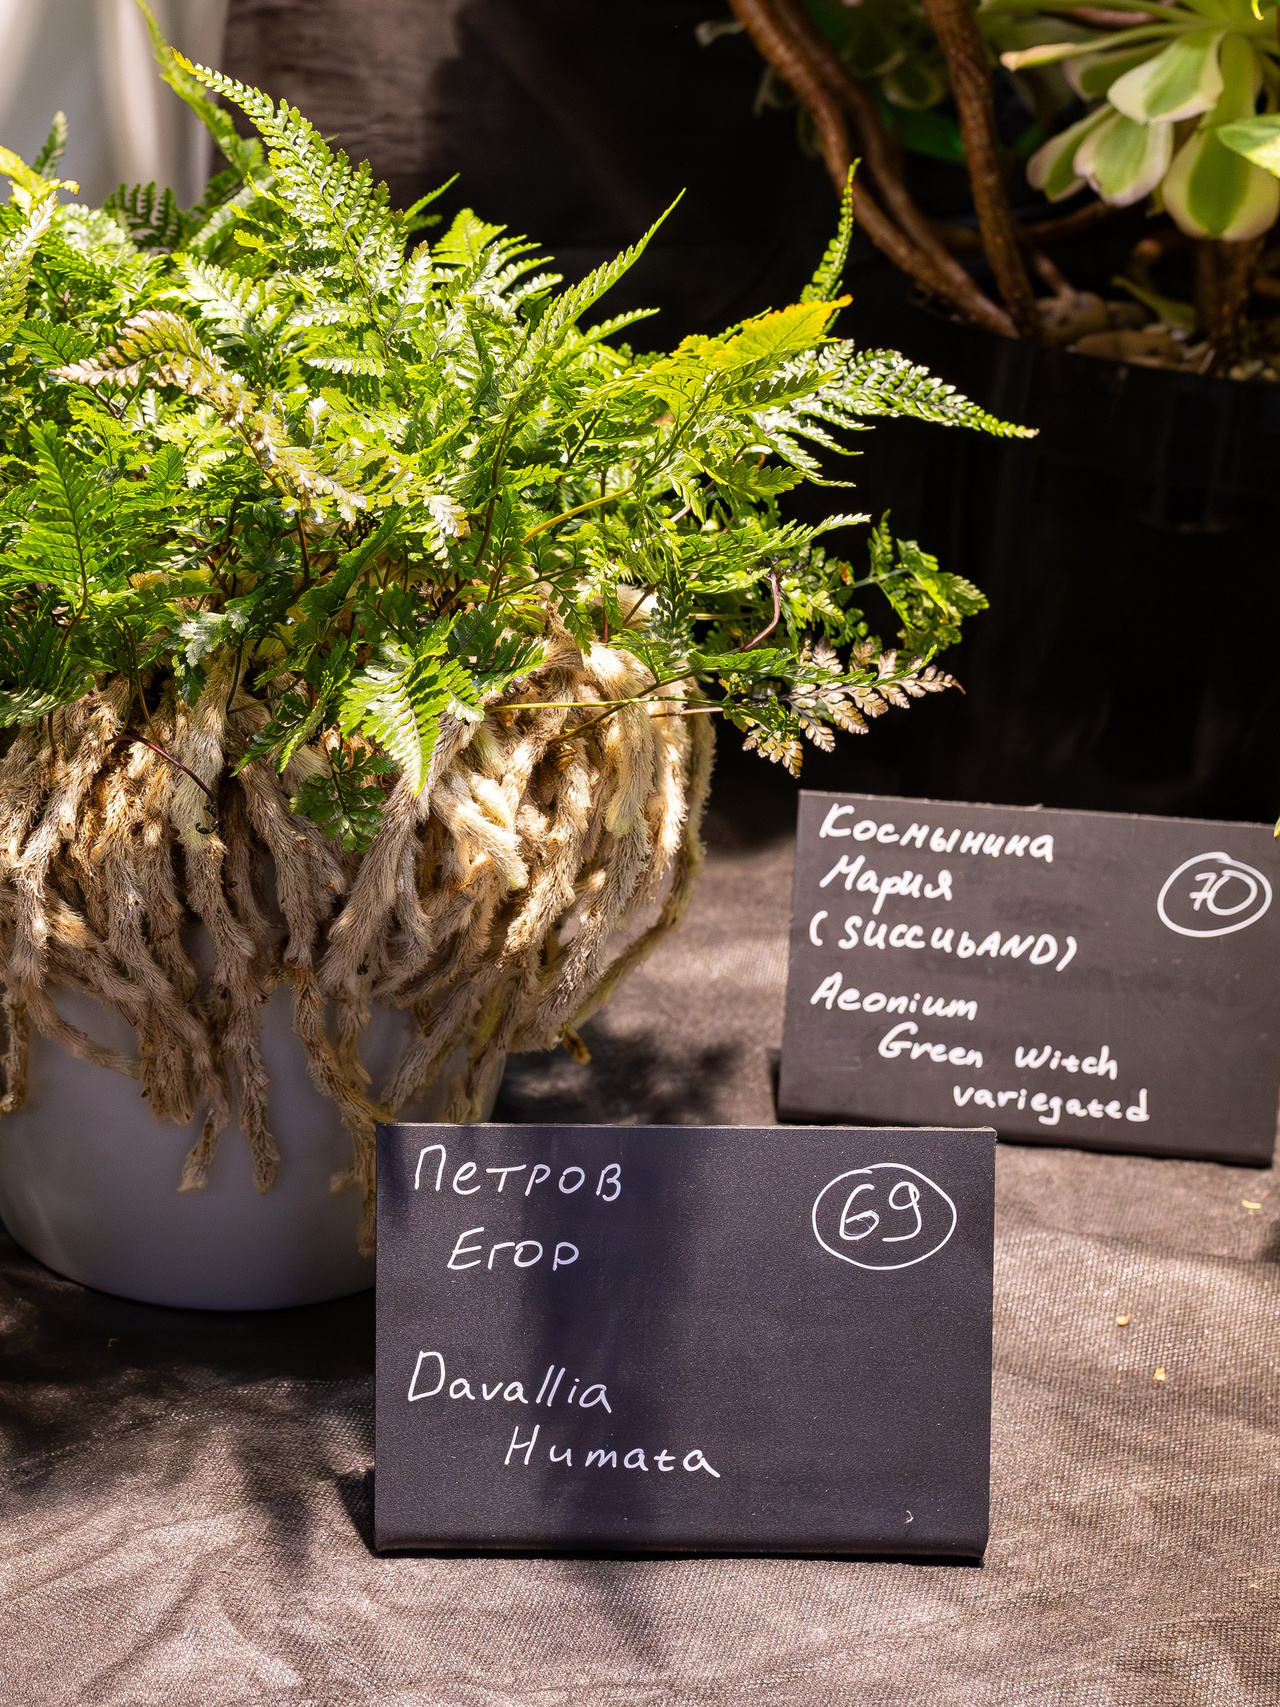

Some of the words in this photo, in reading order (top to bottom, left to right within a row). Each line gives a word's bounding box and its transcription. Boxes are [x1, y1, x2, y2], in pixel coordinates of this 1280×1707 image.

[817, 854, 953, 916] Мария
[1188, 870, 1261, 916] 70
[809, 971, 978, 1021] Aeonium
[877, 1020, 984, 1069] Green
[952, 1085, 1150, 1126] variegated
[414, 1143, 622, 1202] Петров
[838, 1180, 923, 1243] 69
[446, 1226, 580, 1272] Егор
[407, 1349, 612, 1414] Davallia
[504, 1424, 721, 1478] Humata
